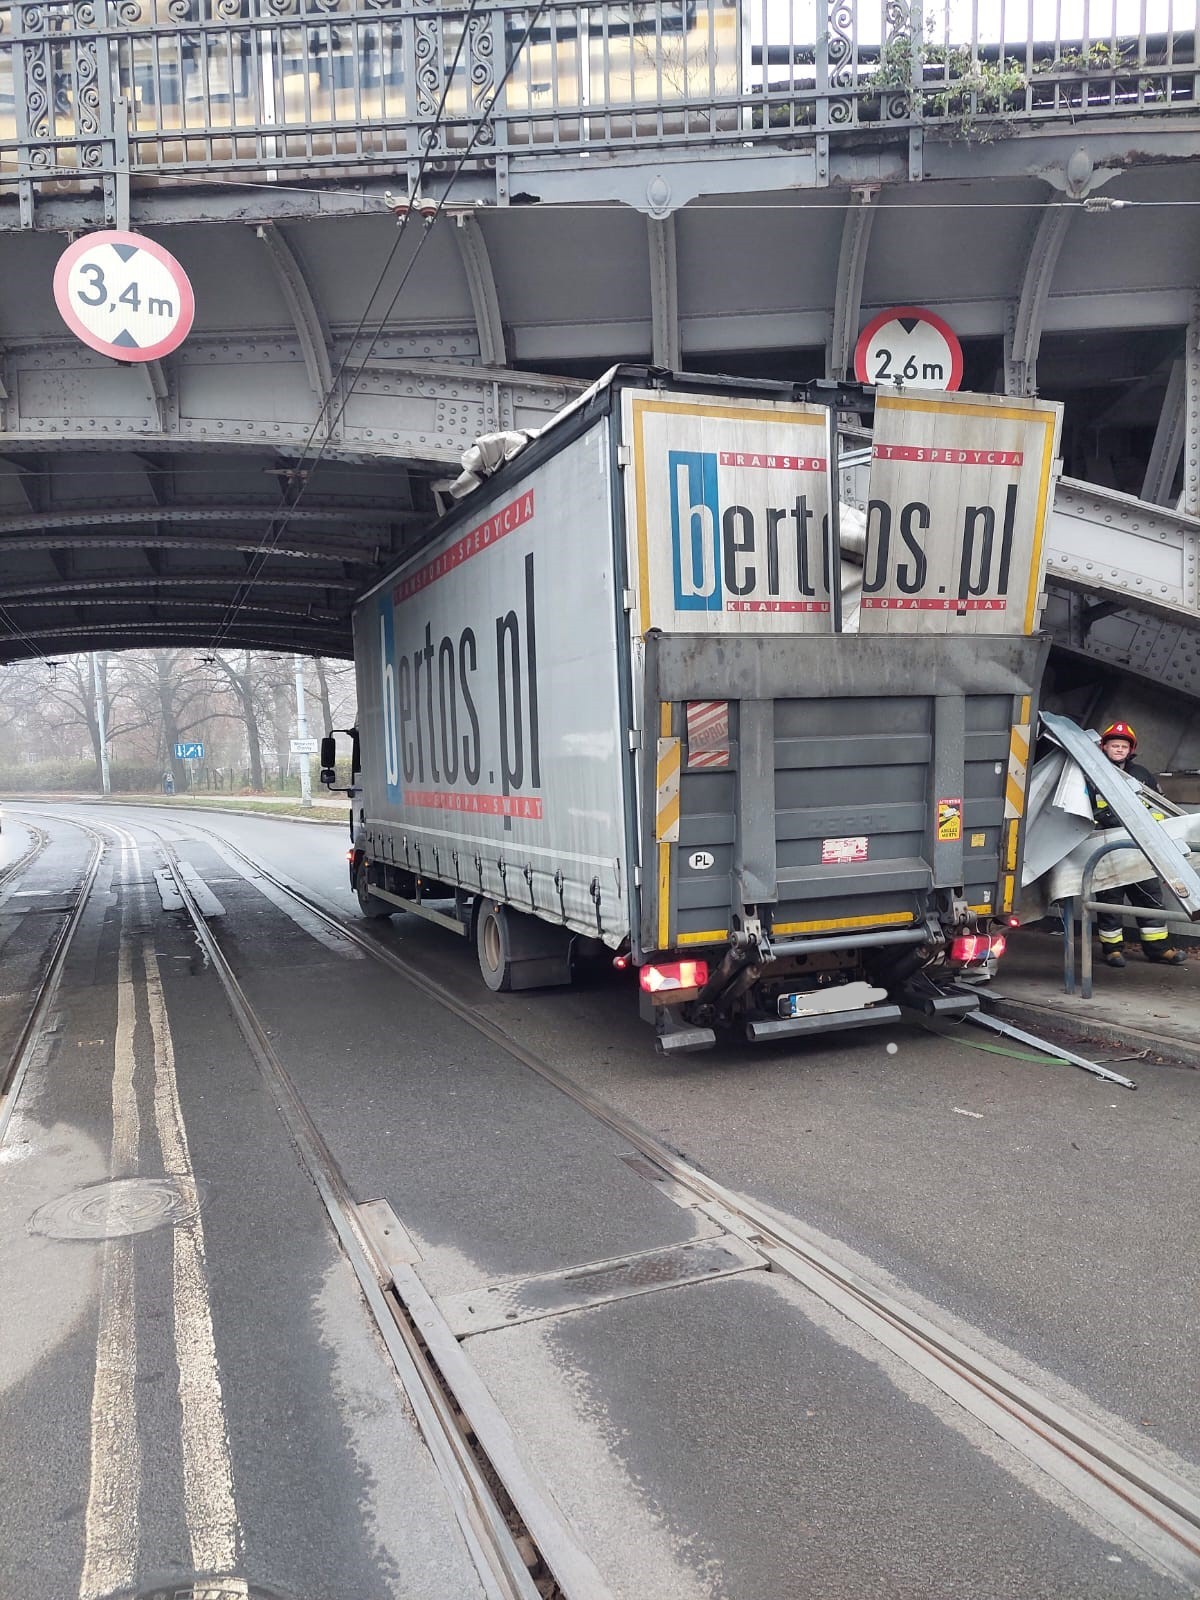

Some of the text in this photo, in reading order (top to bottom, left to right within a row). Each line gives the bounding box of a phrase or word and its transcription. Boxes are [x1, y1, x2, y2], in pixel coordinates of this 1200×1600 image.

[77, 263, 173, 317] 3,4 m
[875, 349, 944, 380] 26 m
[916, 449, 1021, 464] SPEDYCJA
[458, 496, 532, 560] SPEDYCJA
[380, 552, 541, 831] bertos.pl
[1116, 724, 1123, 732] 4
[695, 854, 710, 866] PL
